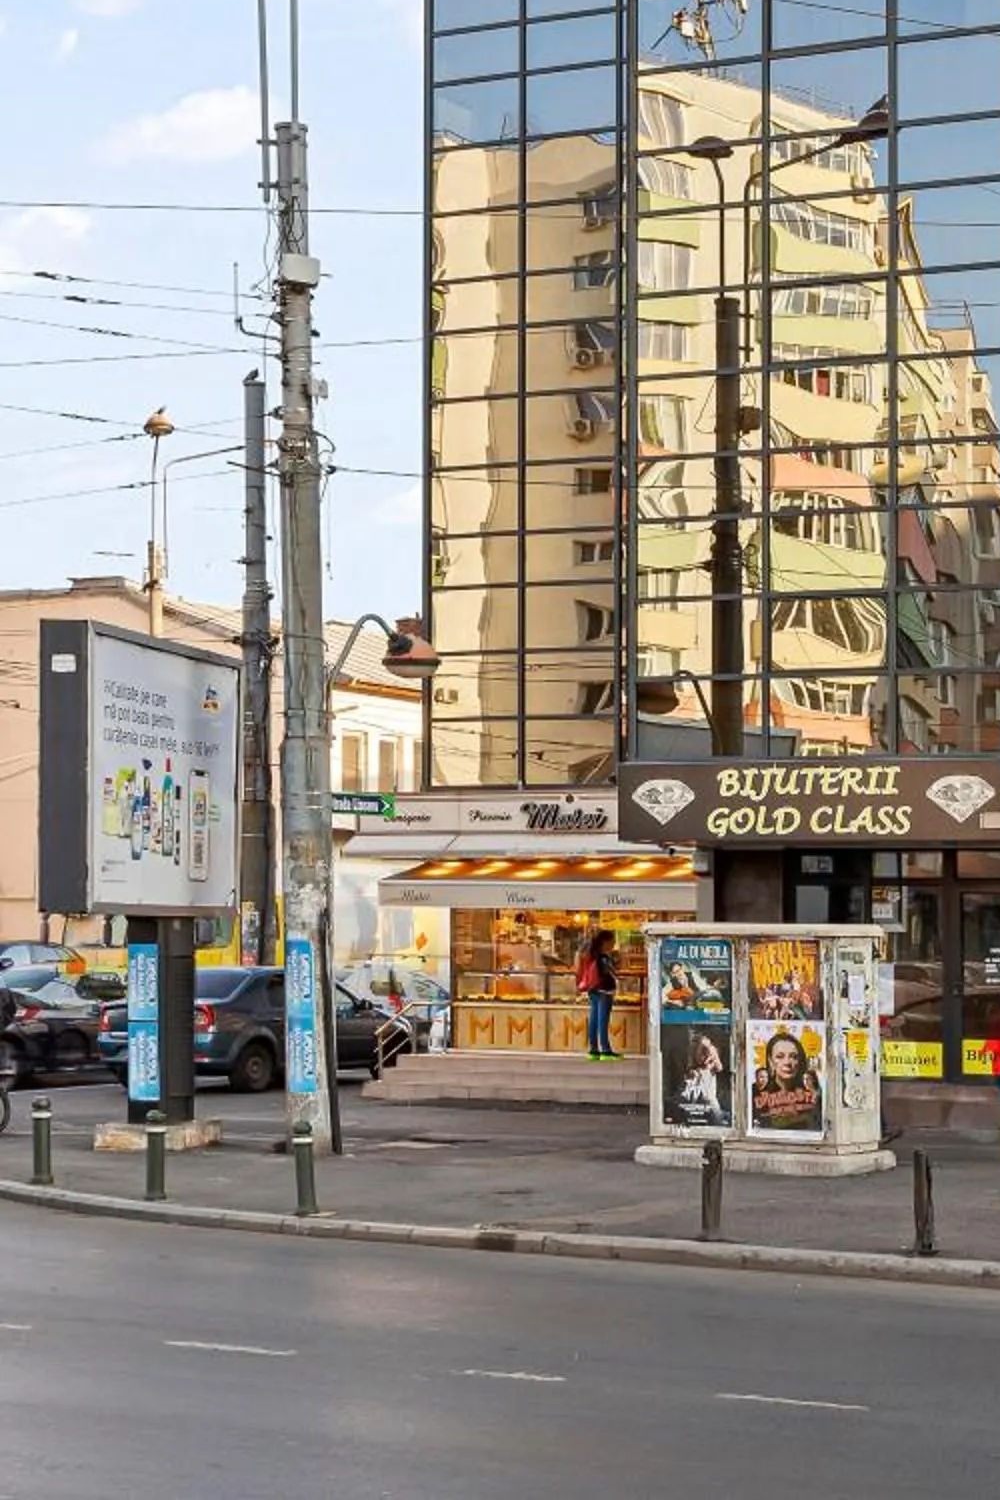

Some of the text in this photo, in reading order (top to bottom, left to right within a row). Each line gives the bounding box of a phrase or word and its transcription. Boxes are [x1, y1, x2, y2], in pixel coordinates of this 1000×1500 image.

[716, 764, 900, 801] BIJUTERII
[706, 804, 912, 837] GOLD CLASS
